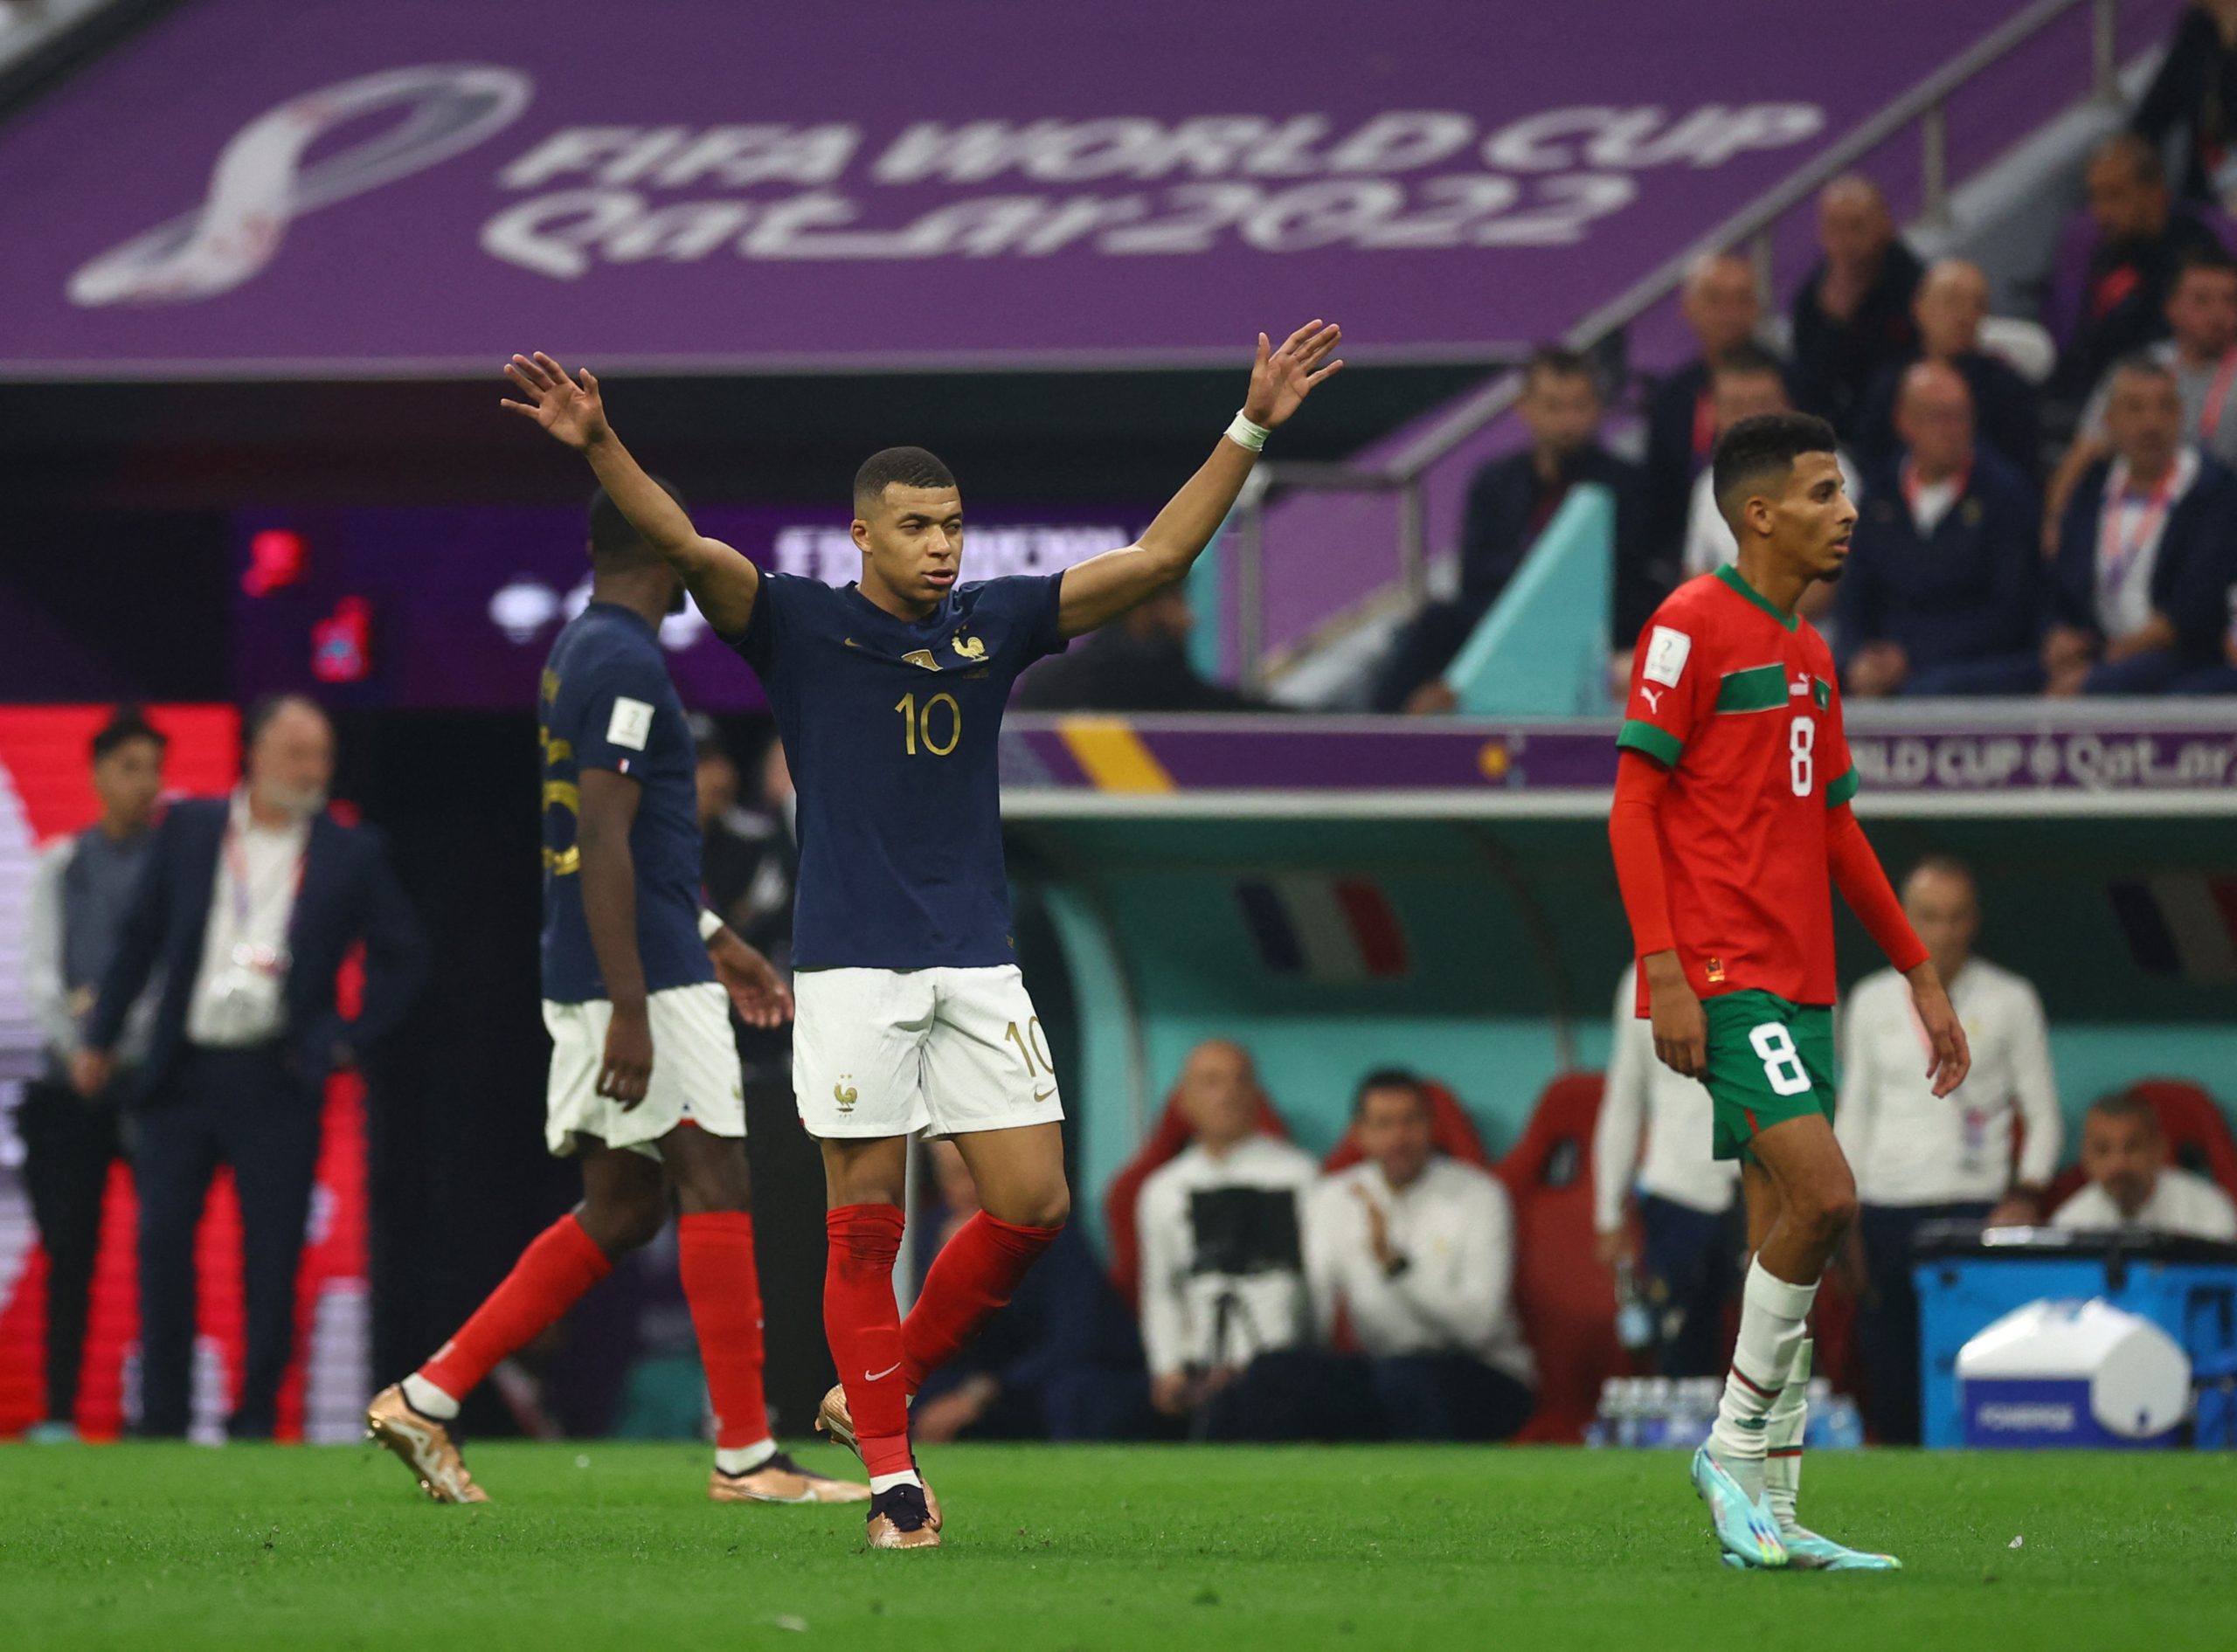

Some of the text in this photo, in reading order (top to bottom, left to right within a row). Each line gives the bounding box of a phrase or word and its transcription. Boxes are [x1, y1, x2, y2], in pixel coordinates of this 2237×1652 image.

[498, 102, 1826, 187] FIFA WORLD CUP
[894, 692, 961, 757] 10
[1790, 715, 1815, 797] 8
[1935, 738, 2022, 785] CUP
[1749, 1021, 1811, 1096] 8
